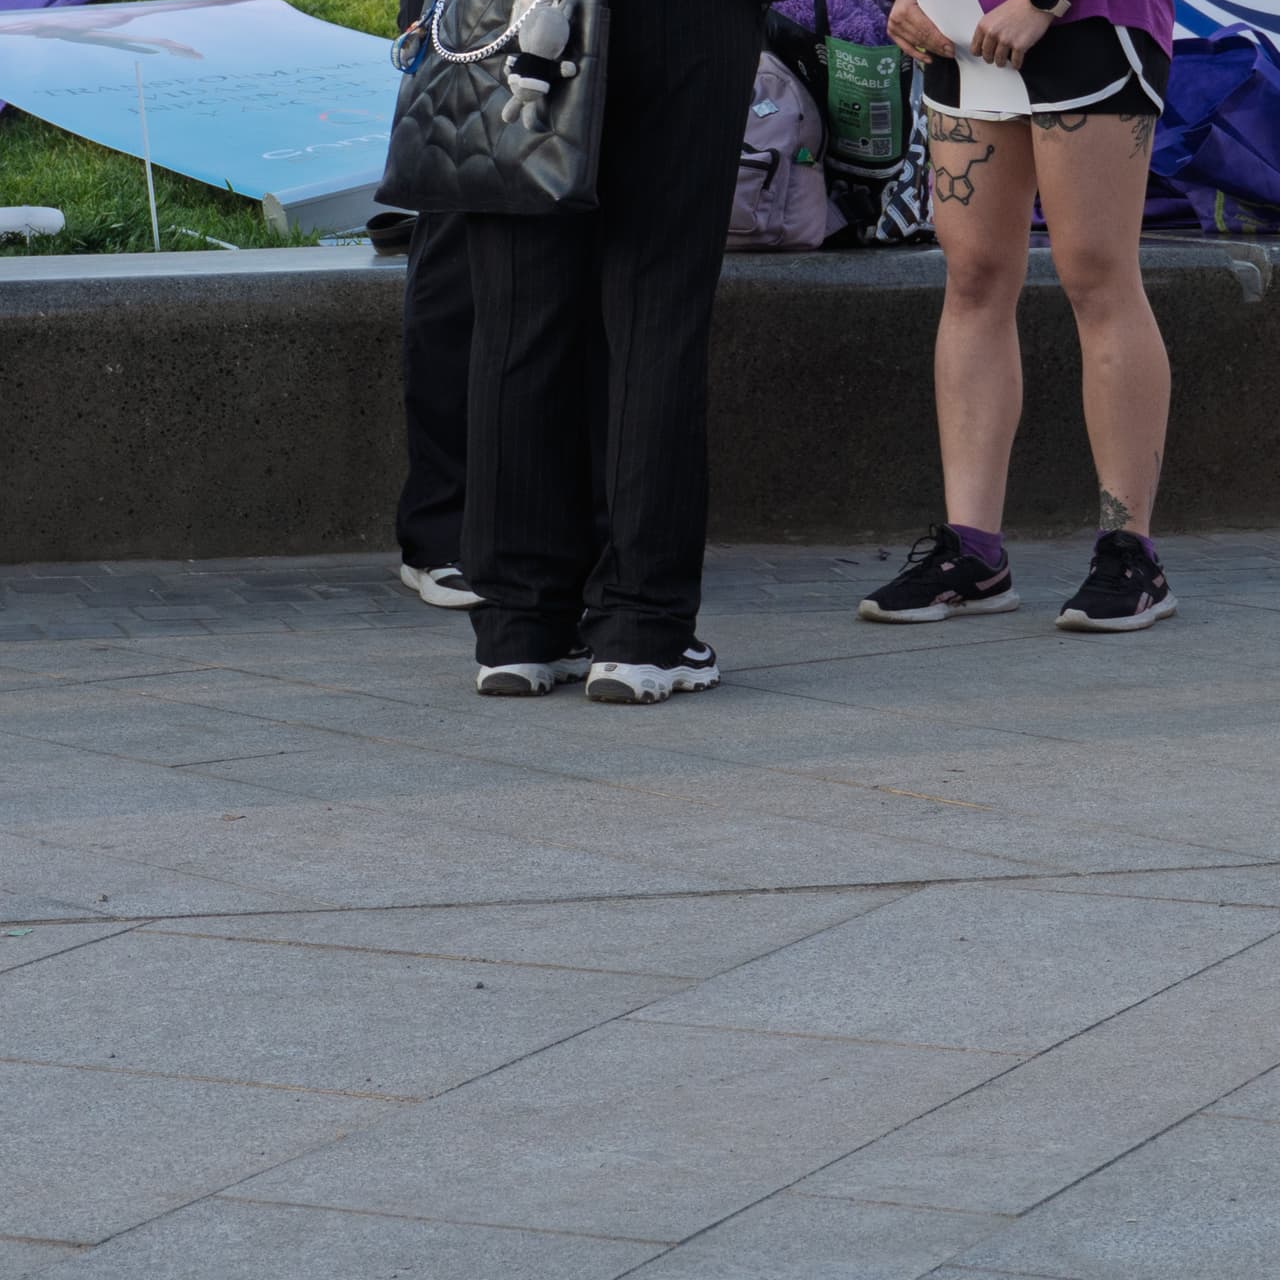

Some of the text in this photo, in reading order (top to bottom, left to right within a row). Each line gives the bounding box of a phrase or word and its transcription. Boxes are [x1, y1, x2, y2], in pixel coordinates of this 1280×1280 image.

[834, 49, 869, 68] BOLSA
[835, 59, 856, 74] ECO
[834, 69, 891, 89] AMIGABLE
